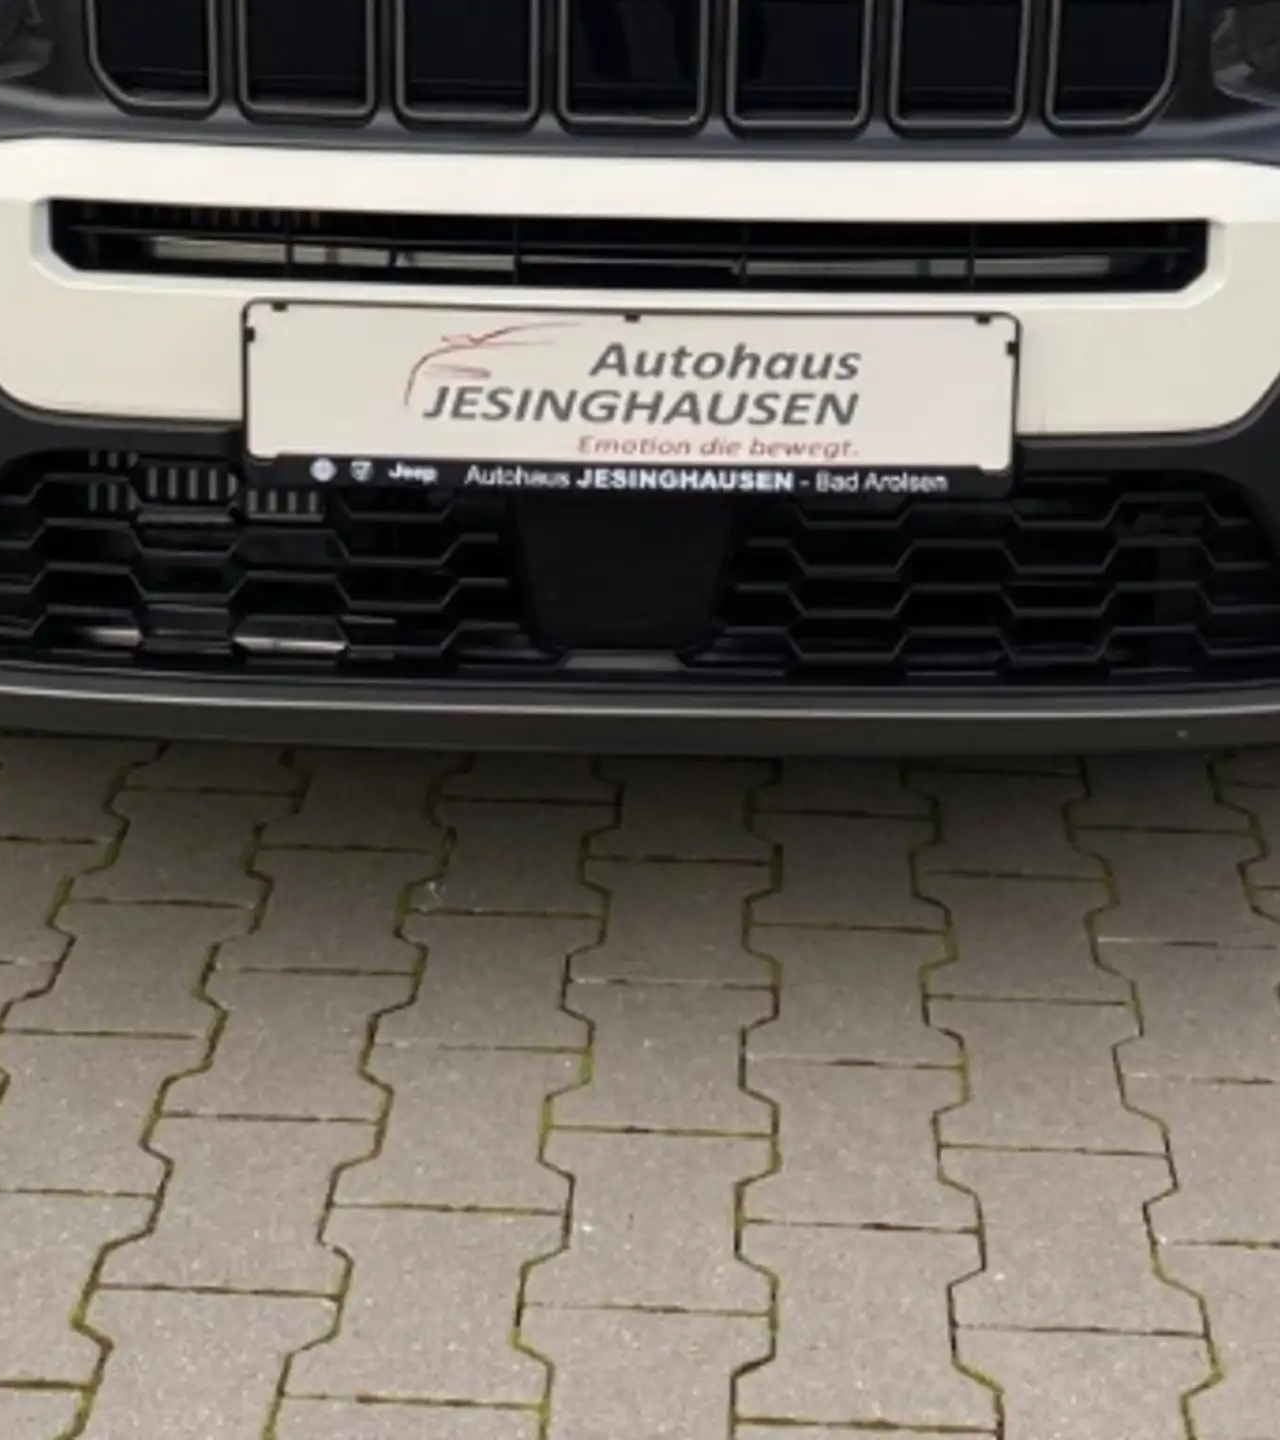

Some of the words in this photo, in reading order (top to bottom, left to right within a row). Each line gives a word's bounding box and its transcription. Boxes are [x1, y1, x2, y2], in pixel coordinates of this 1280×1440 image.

[588, 342, 862, 381] Autohaus
[422, 385, 860, 427] JESINGHAUSEN
[576, 435, 692, 457] Emotion
[699, 435, 742, 457] die
[748, 436, 859, 460] bewegt.
[387, 461, 439, 485] Jeep
[464, 463, 571, 489] Autohaus
[576, 467, 795, 492] JESINGHAUSEN
[815, 469, 860, 492] Bad
[863, 470, 949, 493] Arolsen
